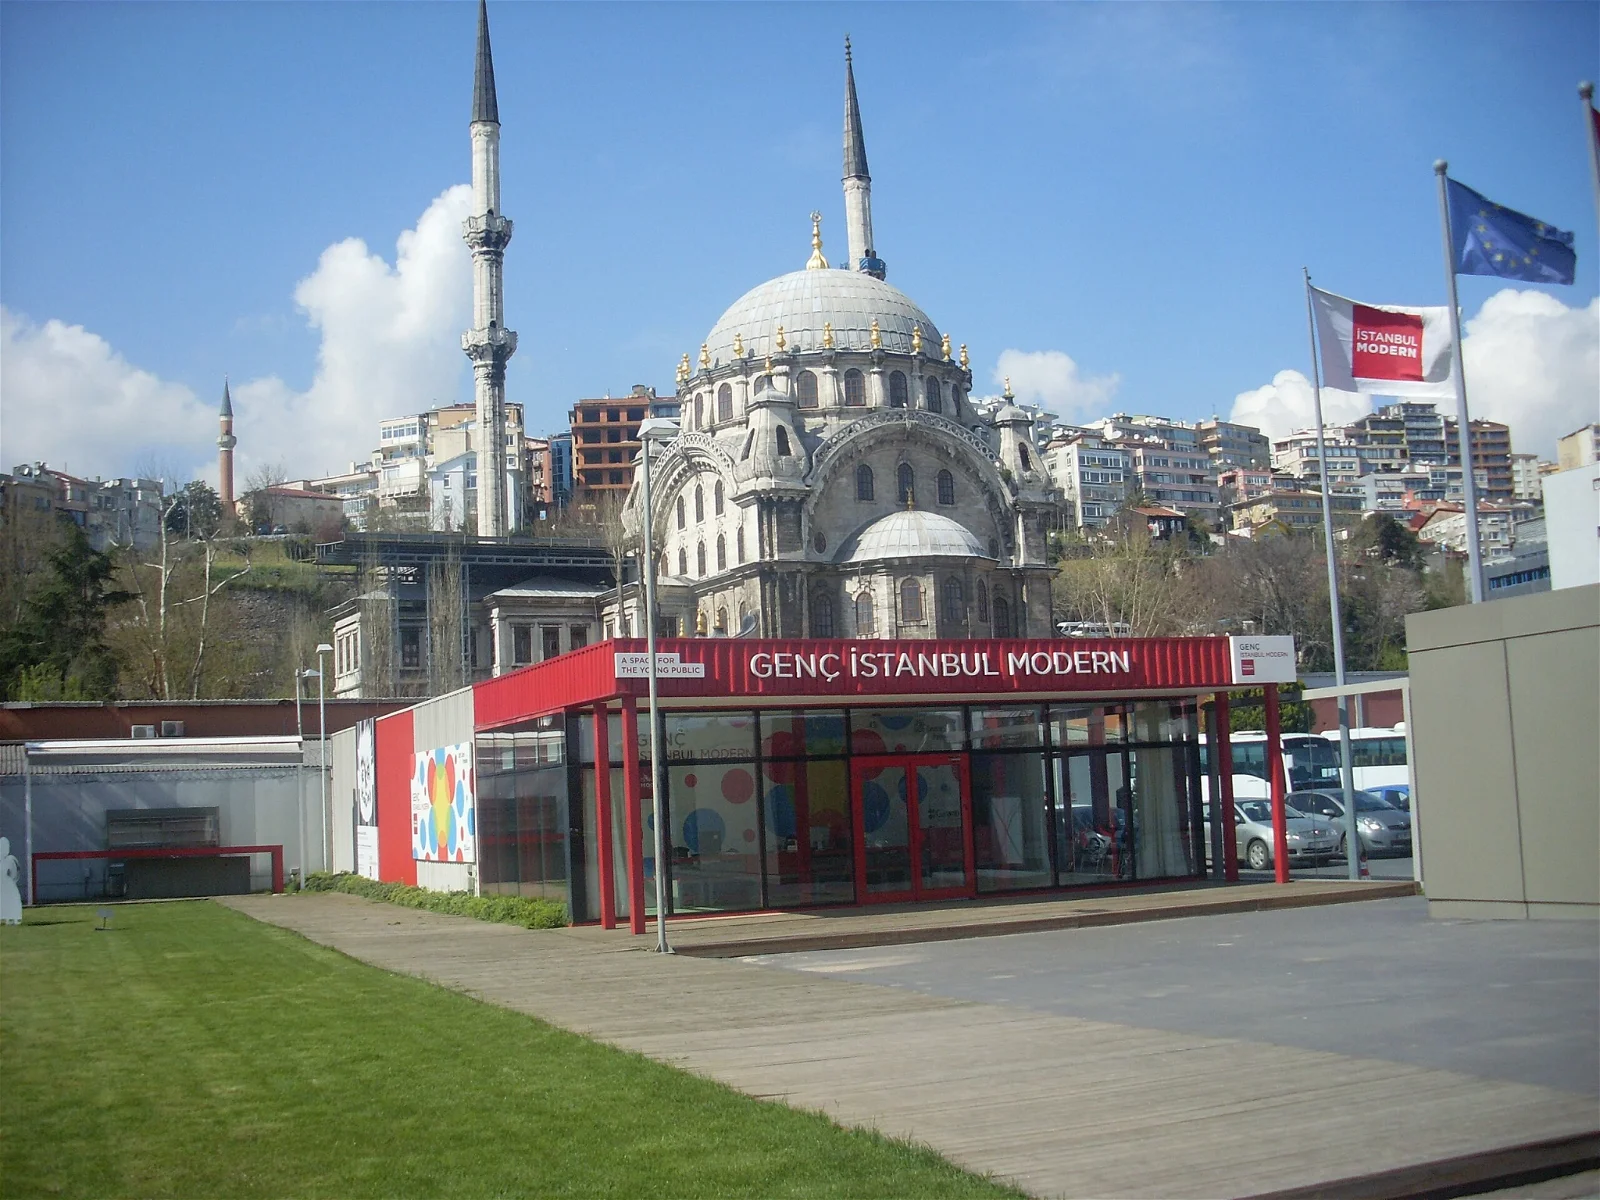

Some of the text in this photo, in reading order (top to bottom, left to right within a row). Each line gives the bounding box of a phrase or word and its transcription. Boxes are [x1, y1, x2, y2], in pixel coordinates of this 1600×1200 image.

[1356, 328, 1418, 347] İSTANBUL
[1356, 342, 1417, 358] MODERN
[621, 666, 700, 674] THE YONG PUBLIC
[750, 646, 1130, 683] GENÇ İSTANBUL MODERN
[638, 732, 685, 748] GNÇ
